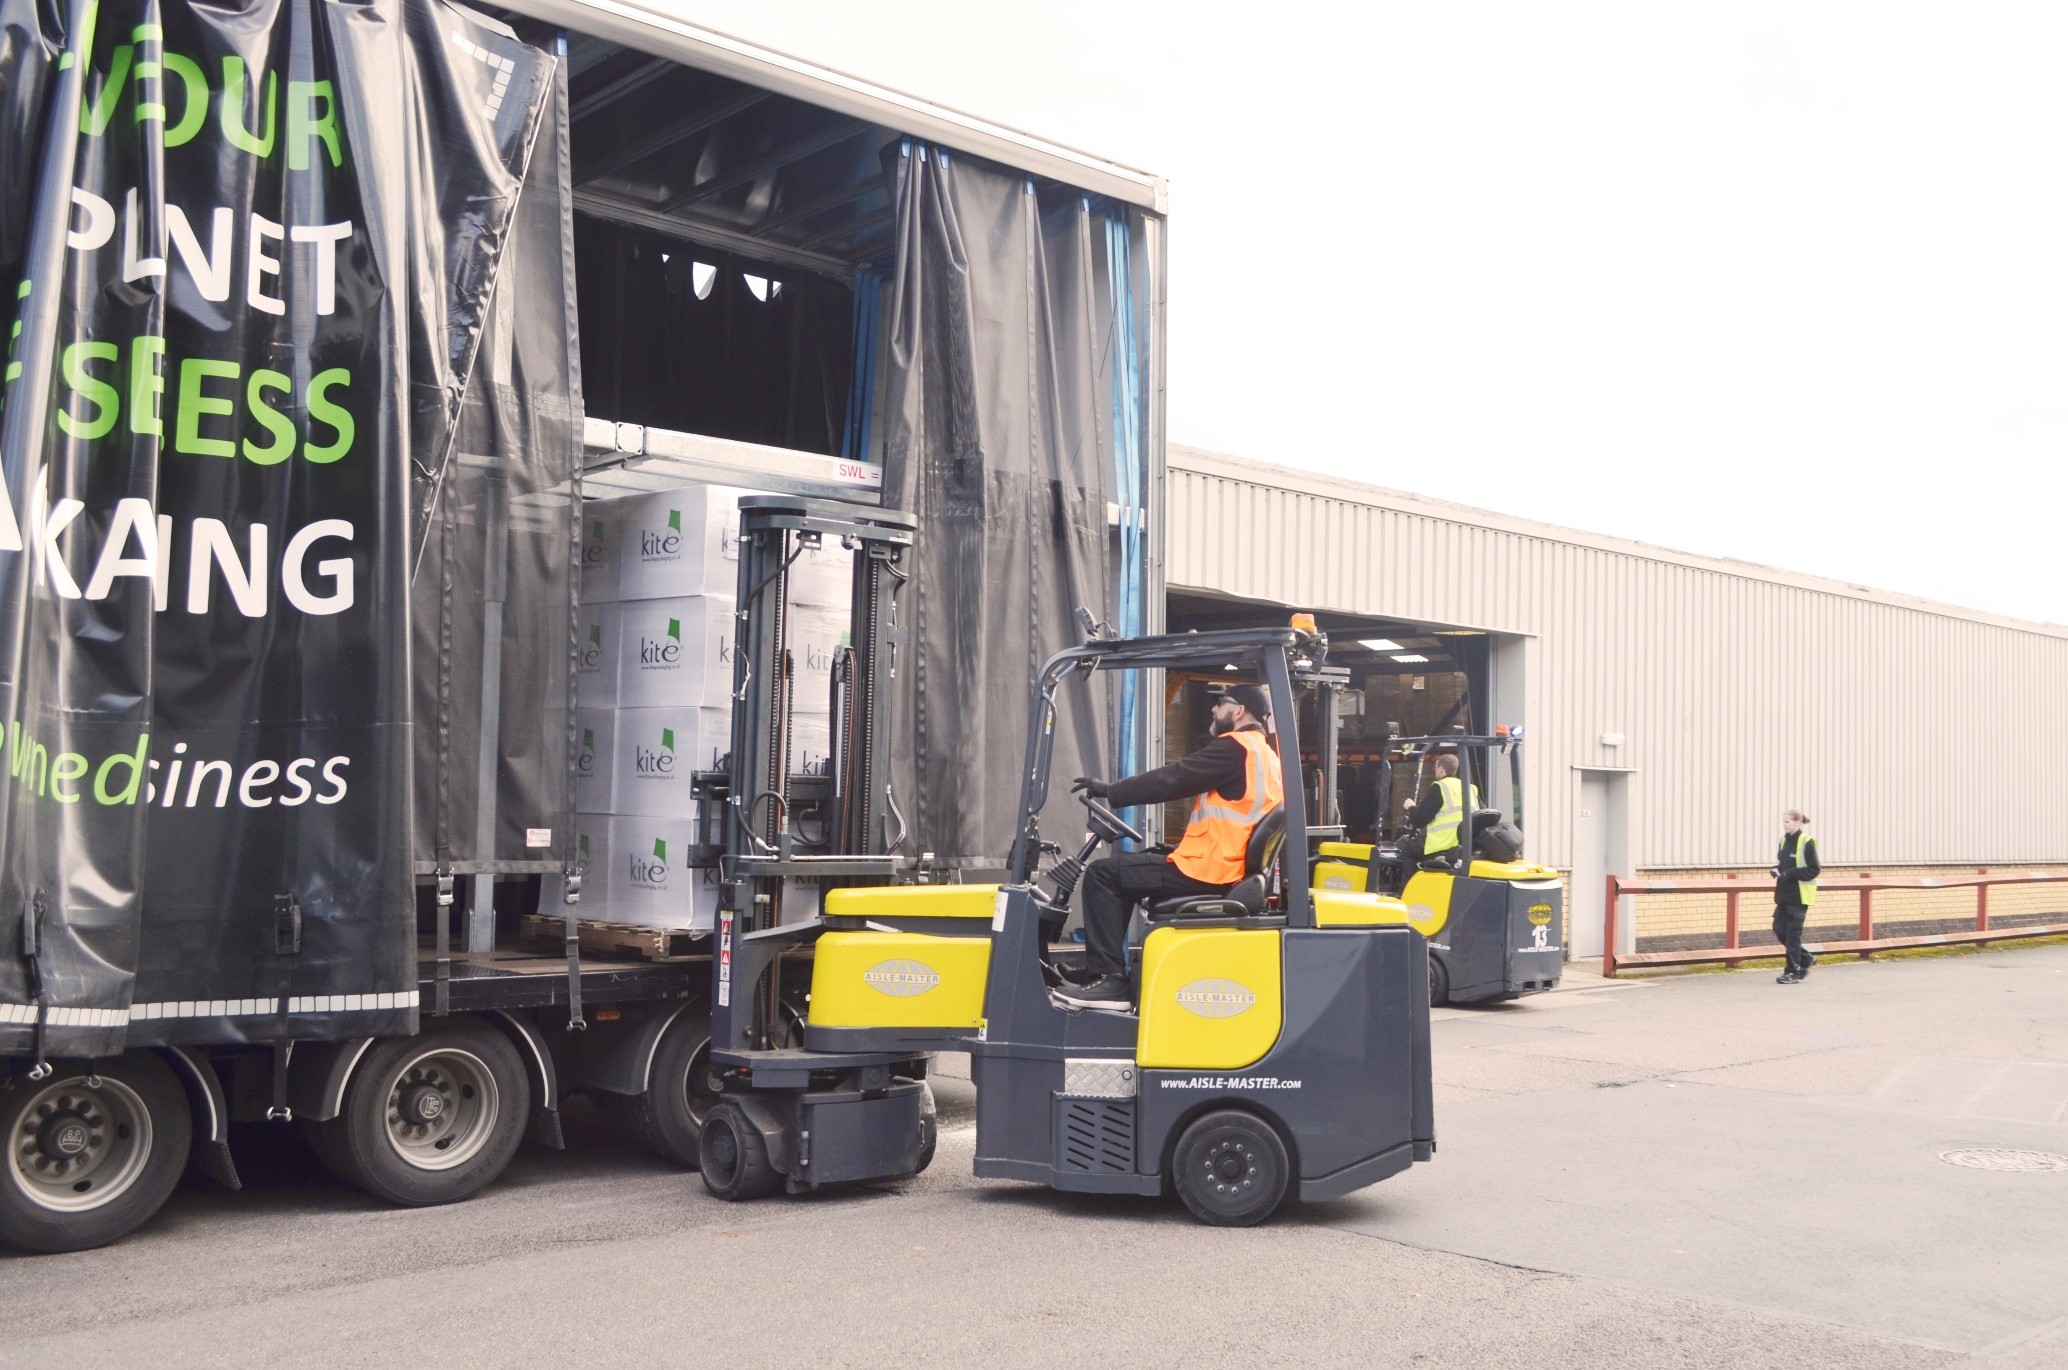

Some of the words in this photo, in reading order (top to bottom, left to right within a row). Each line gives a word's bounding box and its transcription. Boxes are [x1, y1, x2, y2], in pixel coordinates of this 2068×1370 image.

[839, 464, 865, 479] SWL
[642, 530, 680, 555] kite
[641, 637, 680, 663] kite
[806, 643, 830, 671] kit
[636, 745, 675, 773] kite
[630, 854, 667, 883] kite
[1531, 924, 1548, 947] 13
[865, 972, 938, 984] AISLE-MASTER
[1176, 992, 1255, 1004] AISLE-MASTER
